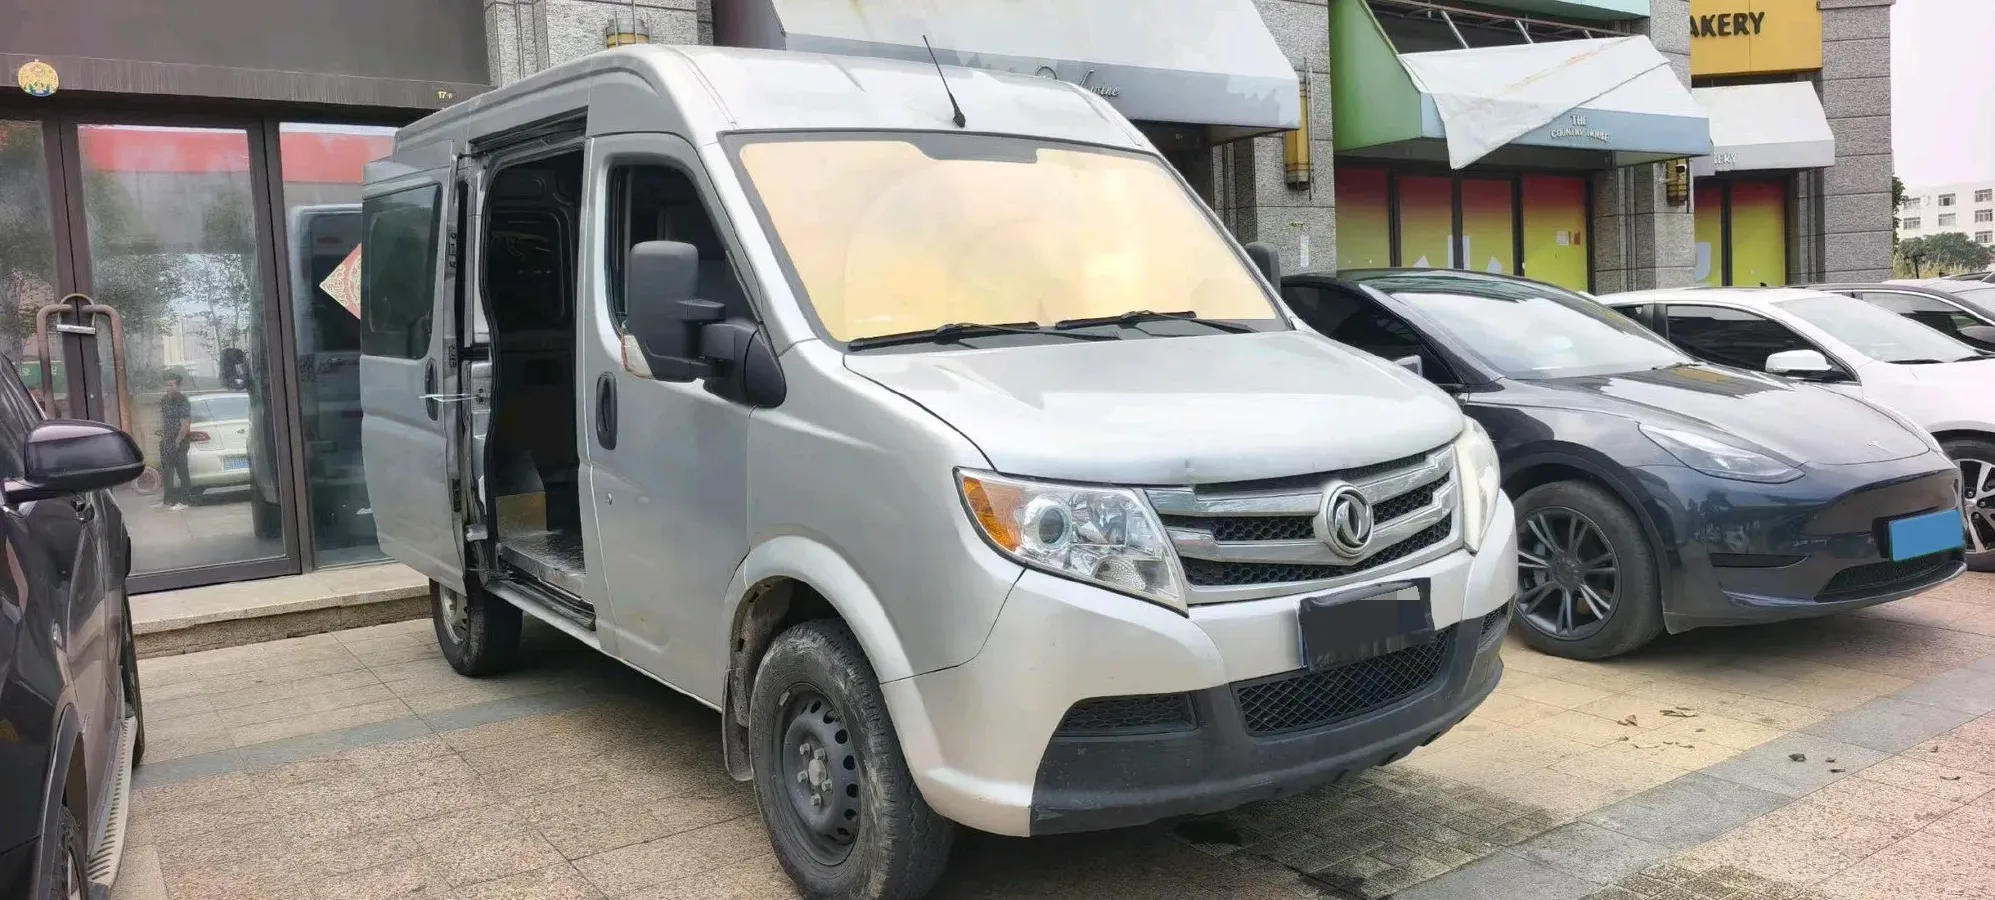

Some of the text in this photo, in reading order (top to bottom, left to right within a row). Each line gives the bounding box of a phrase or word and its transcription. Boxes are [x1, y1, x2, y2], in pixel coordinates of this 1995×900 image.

[1689, 11, 1765, 37] AKERY
[1571, 115, 1587, 126] THE
[1551, 128, 1610, 141] COUNTRY HOUSE
